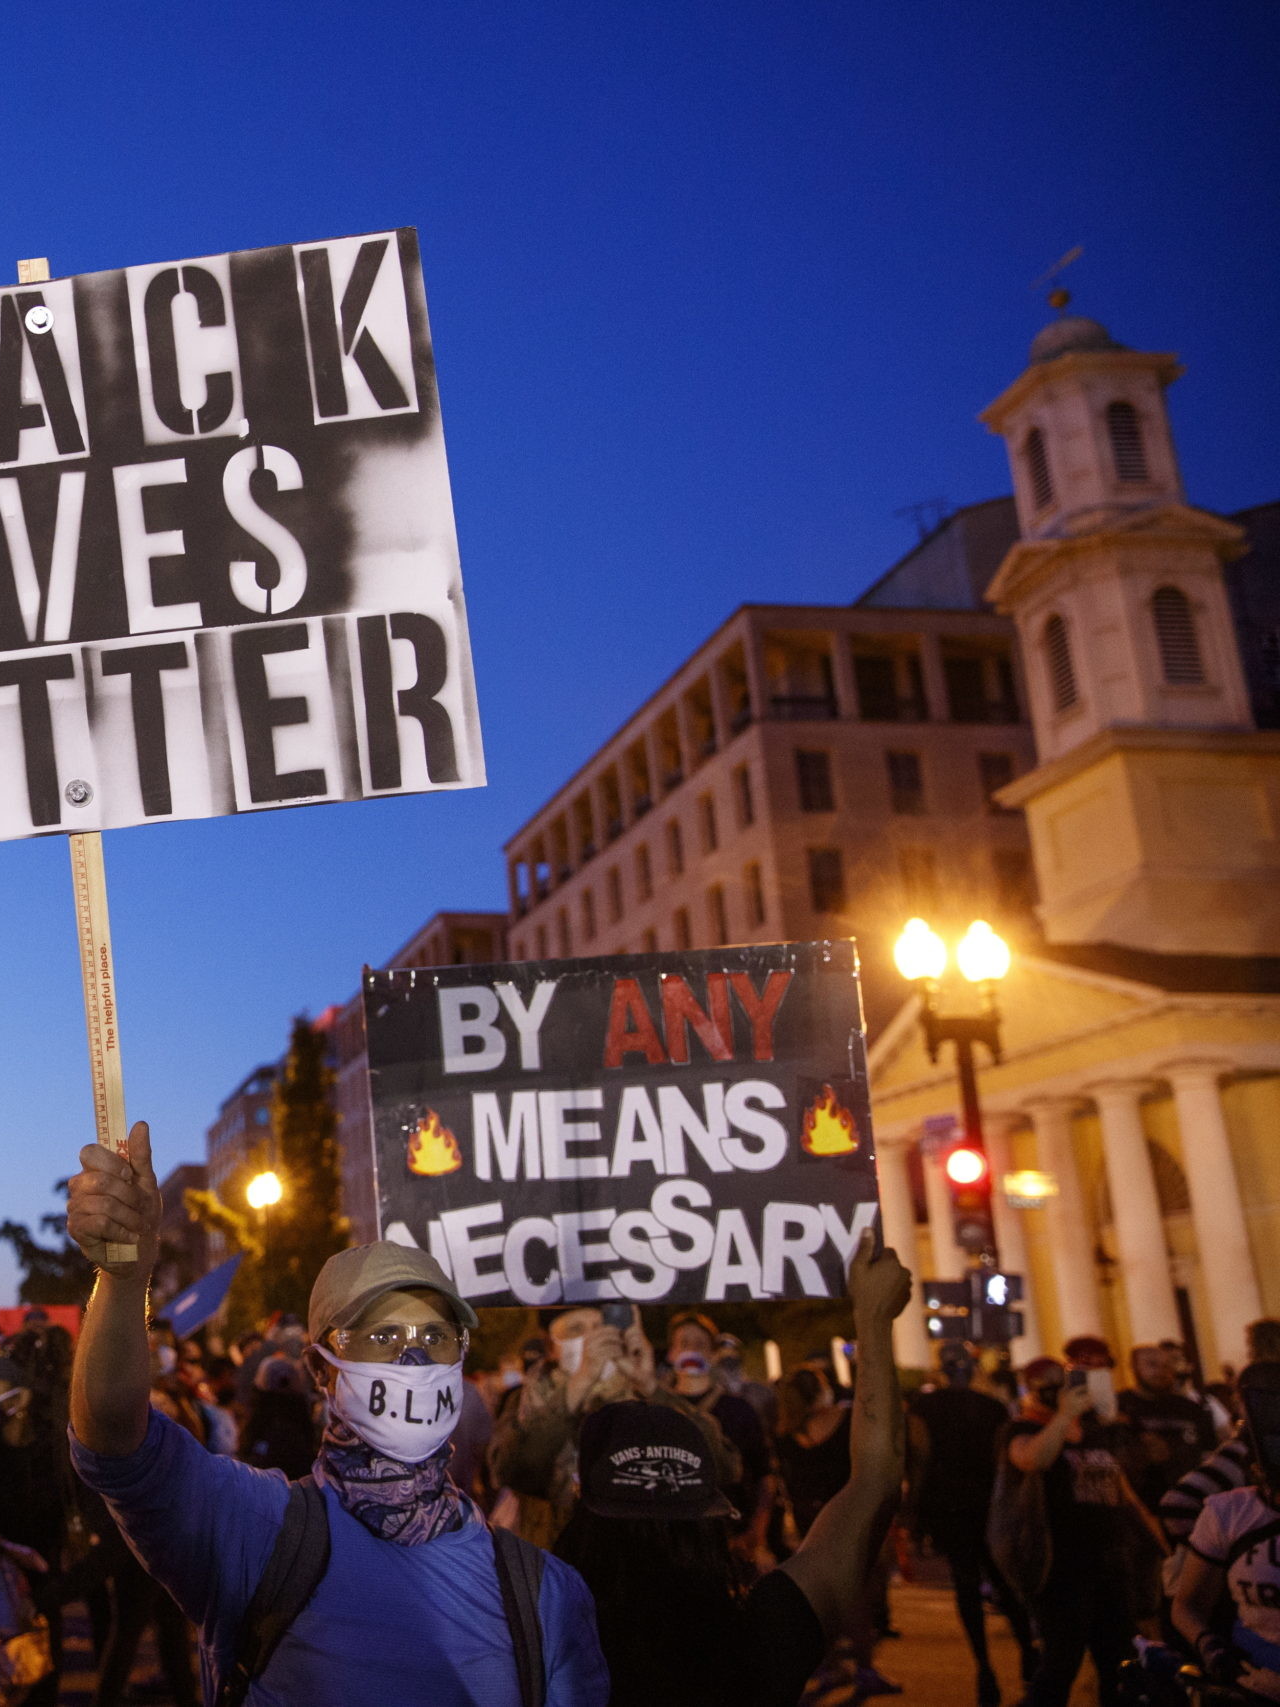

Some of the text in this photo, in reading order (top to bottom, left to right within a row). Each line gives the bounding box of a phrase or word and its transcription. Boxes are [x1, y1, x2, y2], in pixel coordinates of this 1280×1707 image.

[99, 943, 116, 1052] The helpful place.
[437, 971, 794, 1075] BY ANY
[471, 1078, 788, 1183] MEANS
